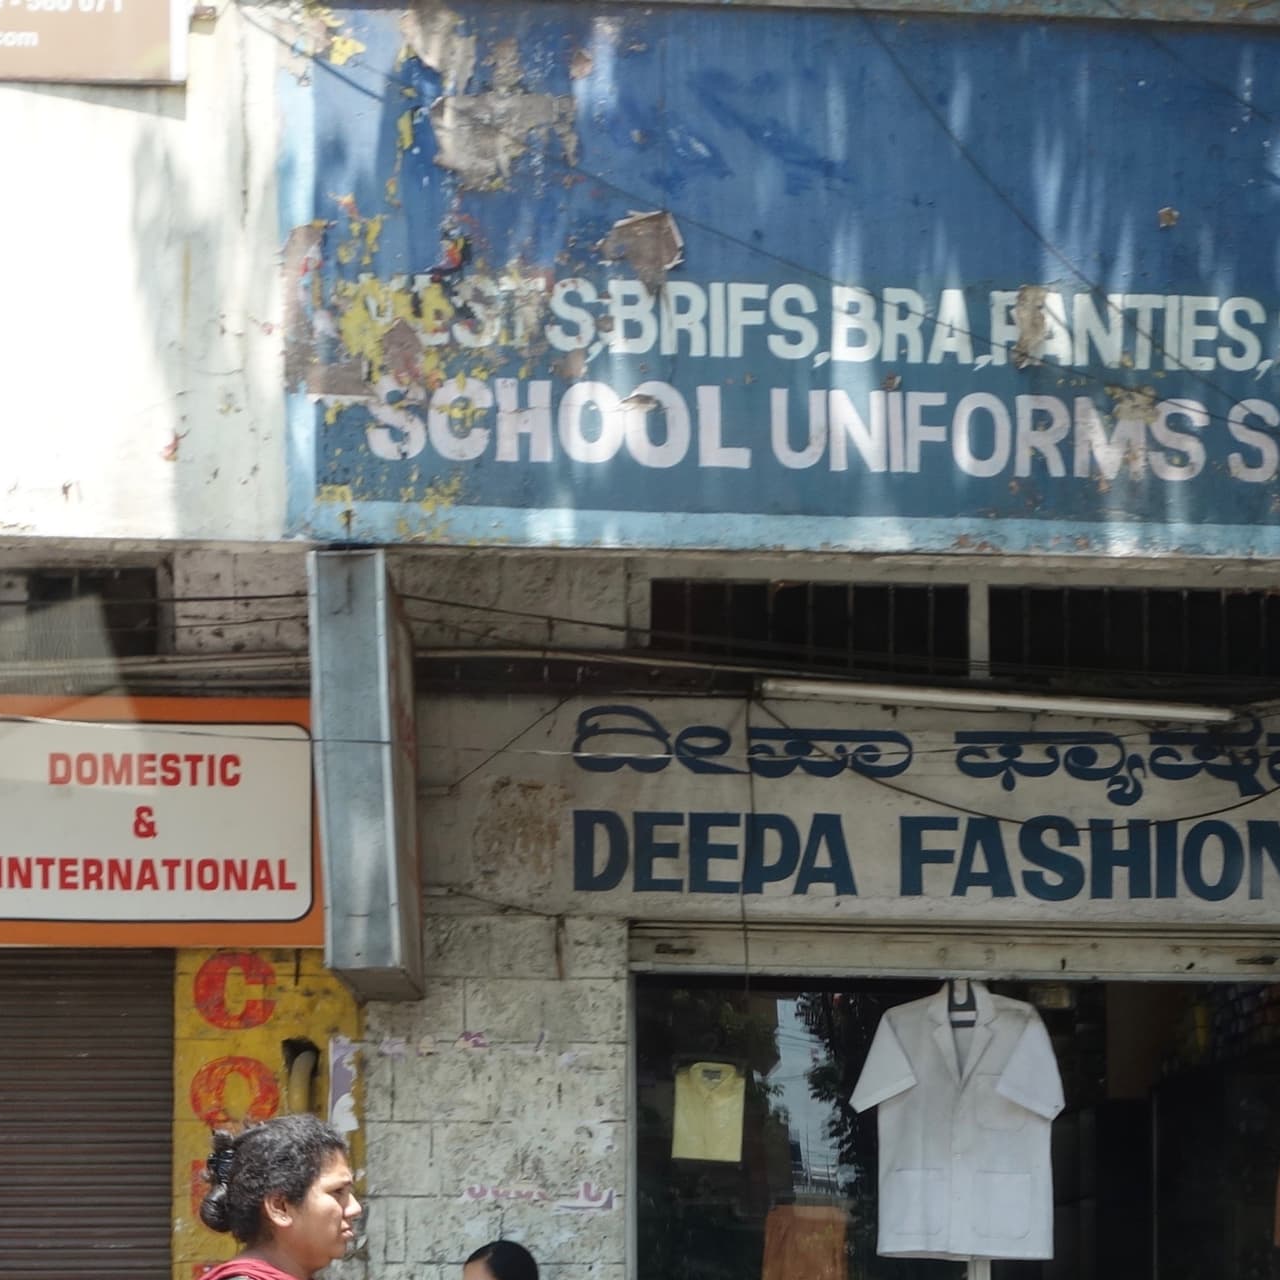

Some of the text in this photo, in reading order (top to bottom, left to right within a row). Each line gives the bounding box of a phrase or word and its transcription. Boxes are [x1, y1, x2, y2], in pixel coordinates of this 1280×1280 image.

[366, 376, 752, 470] SCHOOL
[770, 388, 1210, 482] UNIFORMS
[48, 752, 242, 787] DOMESTIC
[133, 805, 158, 838] &
[573, 809, 858, 897] DEEPA
